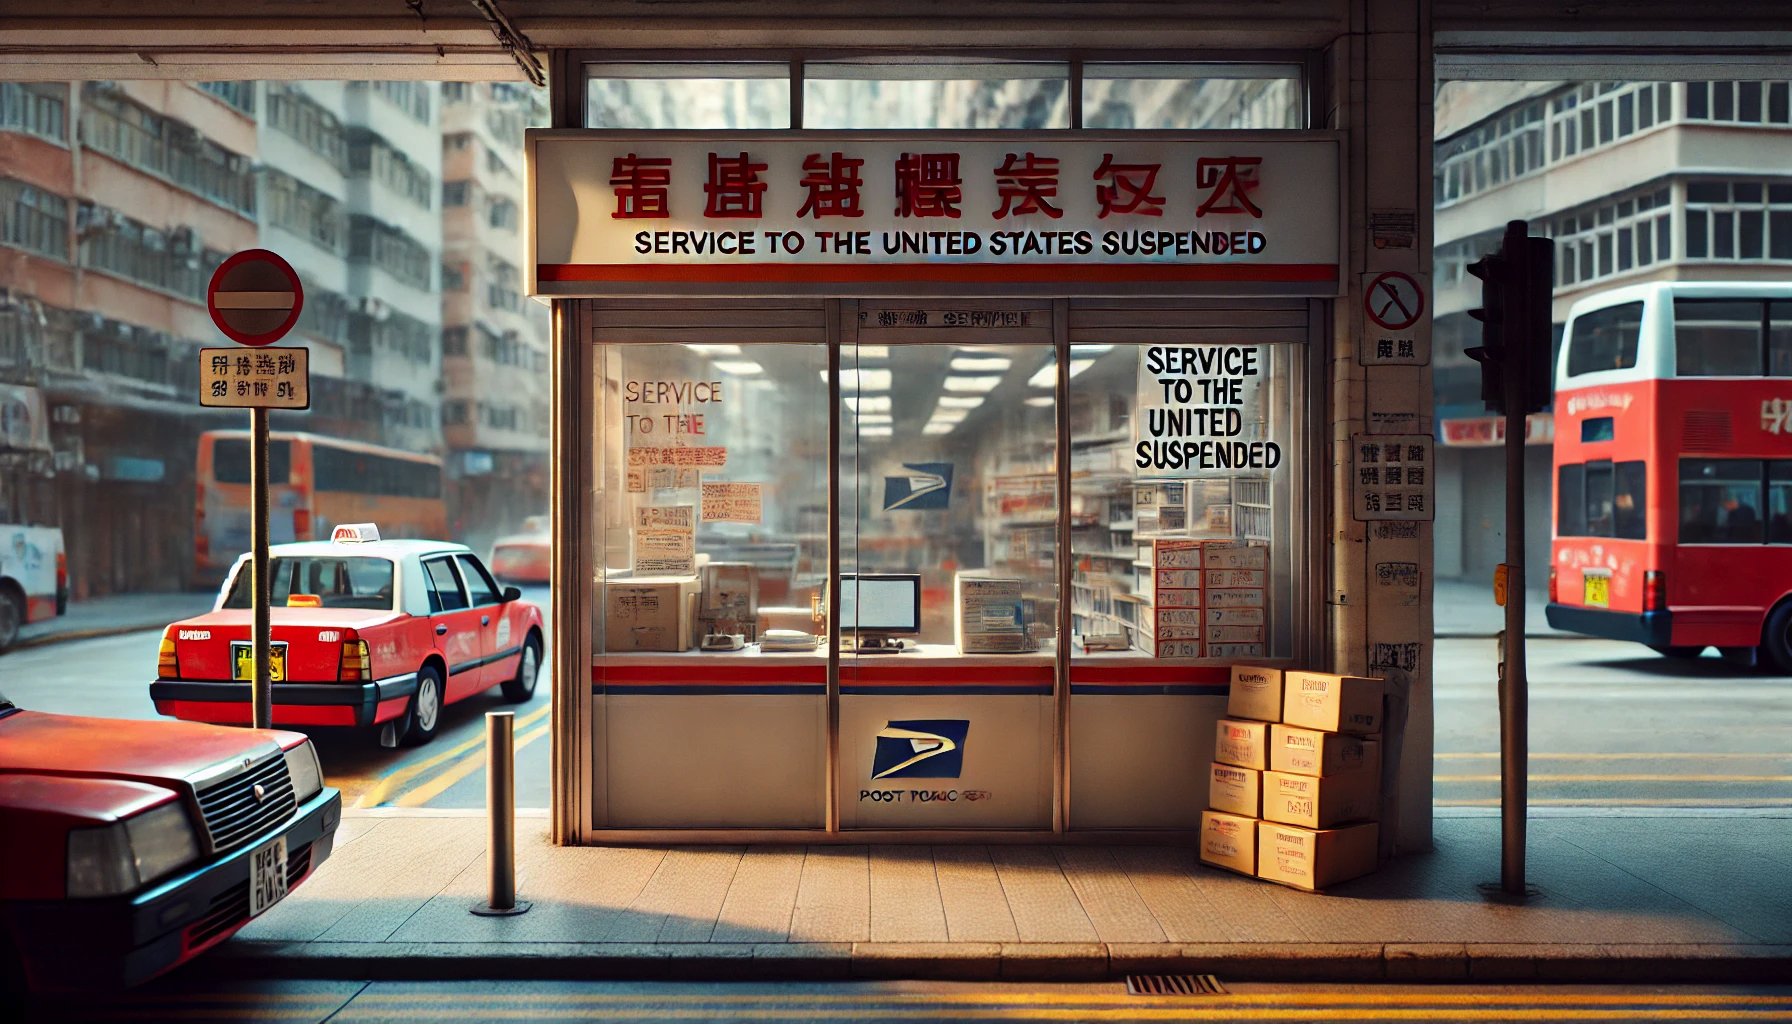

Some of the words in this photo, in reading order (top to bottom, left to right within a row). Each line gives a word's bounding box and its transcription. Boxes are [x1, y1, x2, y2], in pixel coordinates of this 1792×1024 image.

[634, 230, 756, 255] SERVICE
[764, 230, 805, 255] TO
[814, 230, 872, 255] THE
[883, 230, 982, 255] UNITED
[989, 230, 1093, 256] STATES
[1101, 230, 1267, 256] SUSPENDED
[1147, 346, 1258, 376] SERVICE
[625, 380, 723, 405] SERVICE
[1158, 378, 1193, 404] TO
[1197, 377, 1243, 405] THE
[626, 414, 654, 435] TO
[663, 413, 706, 436] THE
[1149, 407, 1242, 438] UNITED
[1136, 440, 1281, 470] SUSPENDED
